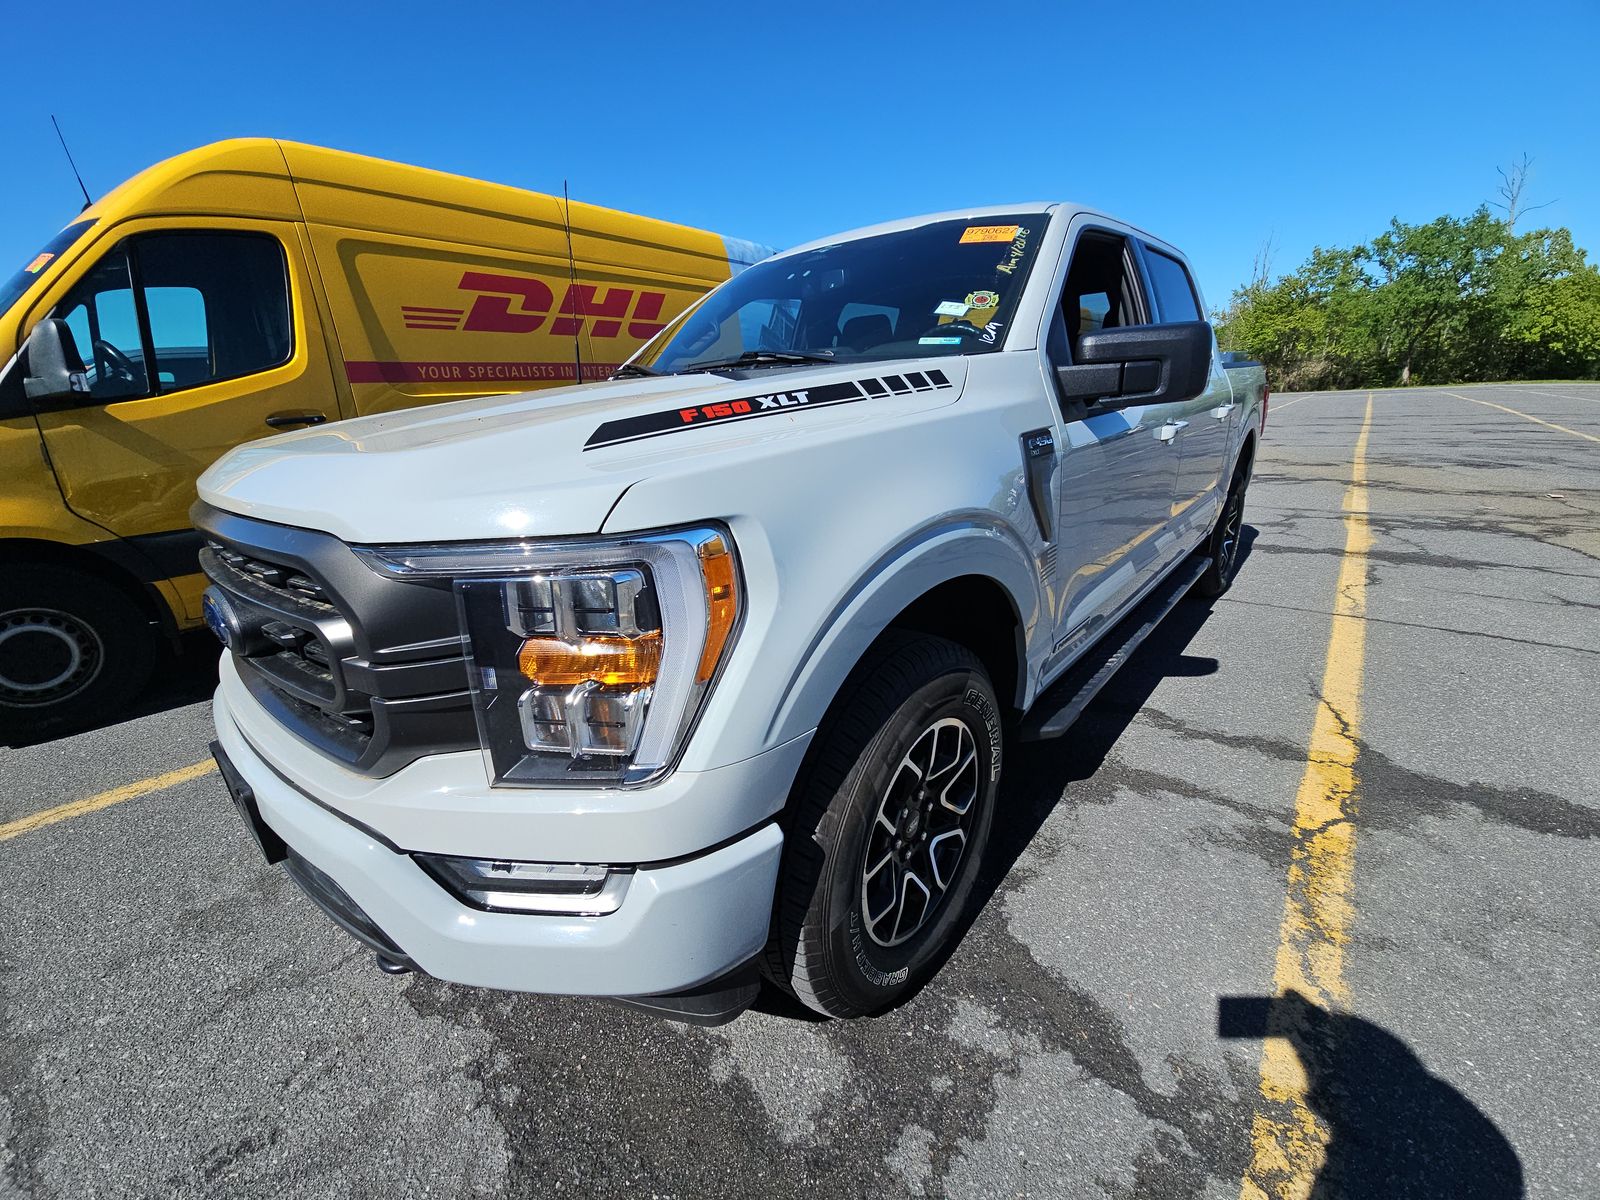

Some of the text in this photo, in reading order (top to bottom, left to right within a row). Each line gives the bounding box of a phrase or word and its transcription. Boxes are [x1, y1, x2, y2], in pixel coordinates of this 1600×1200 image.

[458, 271, 670, 340] DHL
[417, 365, 463, 379] YOUR
[468, 365, 555, 379] SPECIALISTS
[560, 365, 574, 378] IN
[755, 391, 809, 410] XLT
[963, 688, 1001, 782] GENERAL
